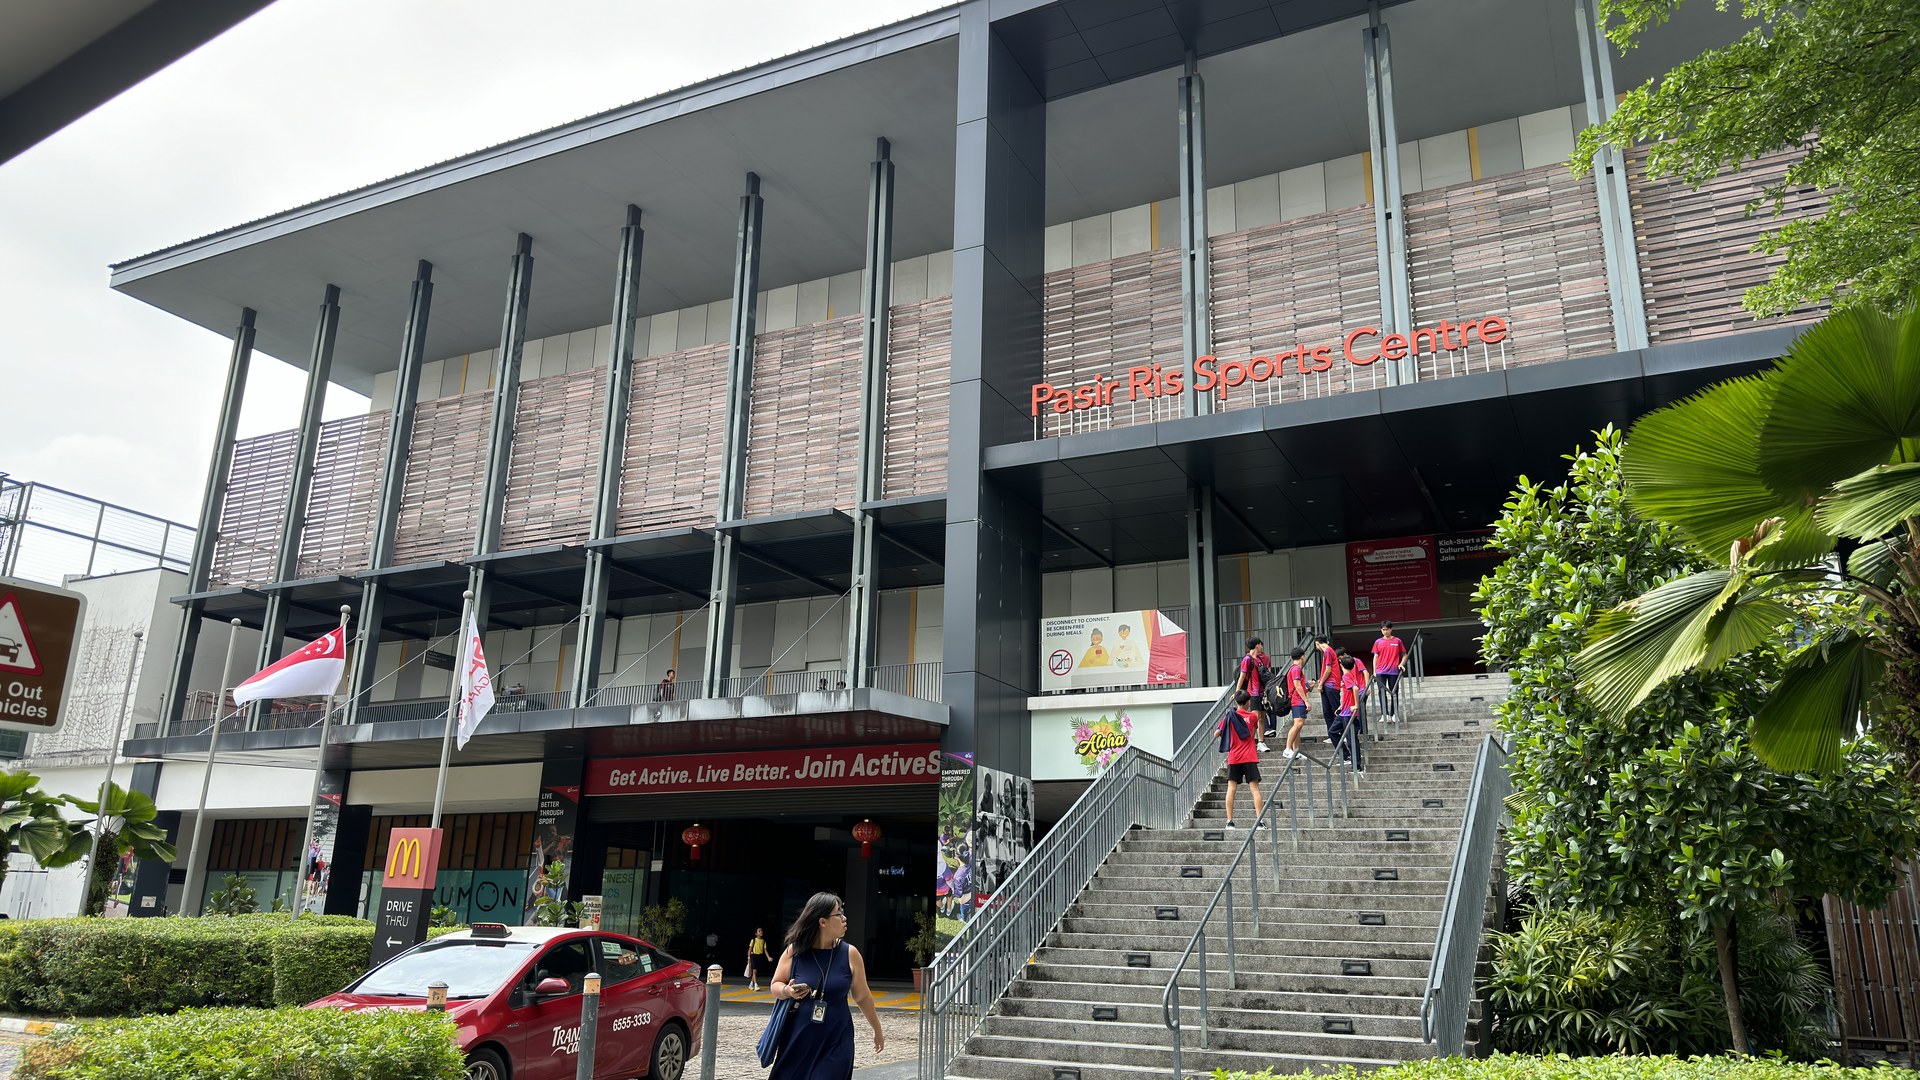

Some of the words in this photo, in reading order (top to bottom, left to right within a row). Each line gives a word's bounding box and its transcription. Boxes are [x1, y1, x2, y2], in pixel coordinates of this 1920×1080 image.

[1032, 375, 1121, 416] Pasir
[1128, 363, 1184, 401] Ris
[1193, 342, 1333, 400] Sports
[1344, 315, 1507, 365] Centre
[1440, 546, 1465, 554] Culture
[8, 682, 43, 700] Out
[1076, 732, 1128, 756] Aloha
[609, 769, 636, 786] Get
[638, 766, 692, 785] Active.
[696, 764, 730, 783] Live
[733, 762, 790, 781] Better.
[794, 754, 846, 779] Join
[850, 750, 941, 777] ActiveS
[386, 900, 413, 912] DRIVE
[385, 915, 409, 927] THRU
[613, 1012, 651, 1031] 6555-3333
[552, 1025, 581, 1047] TRAN
